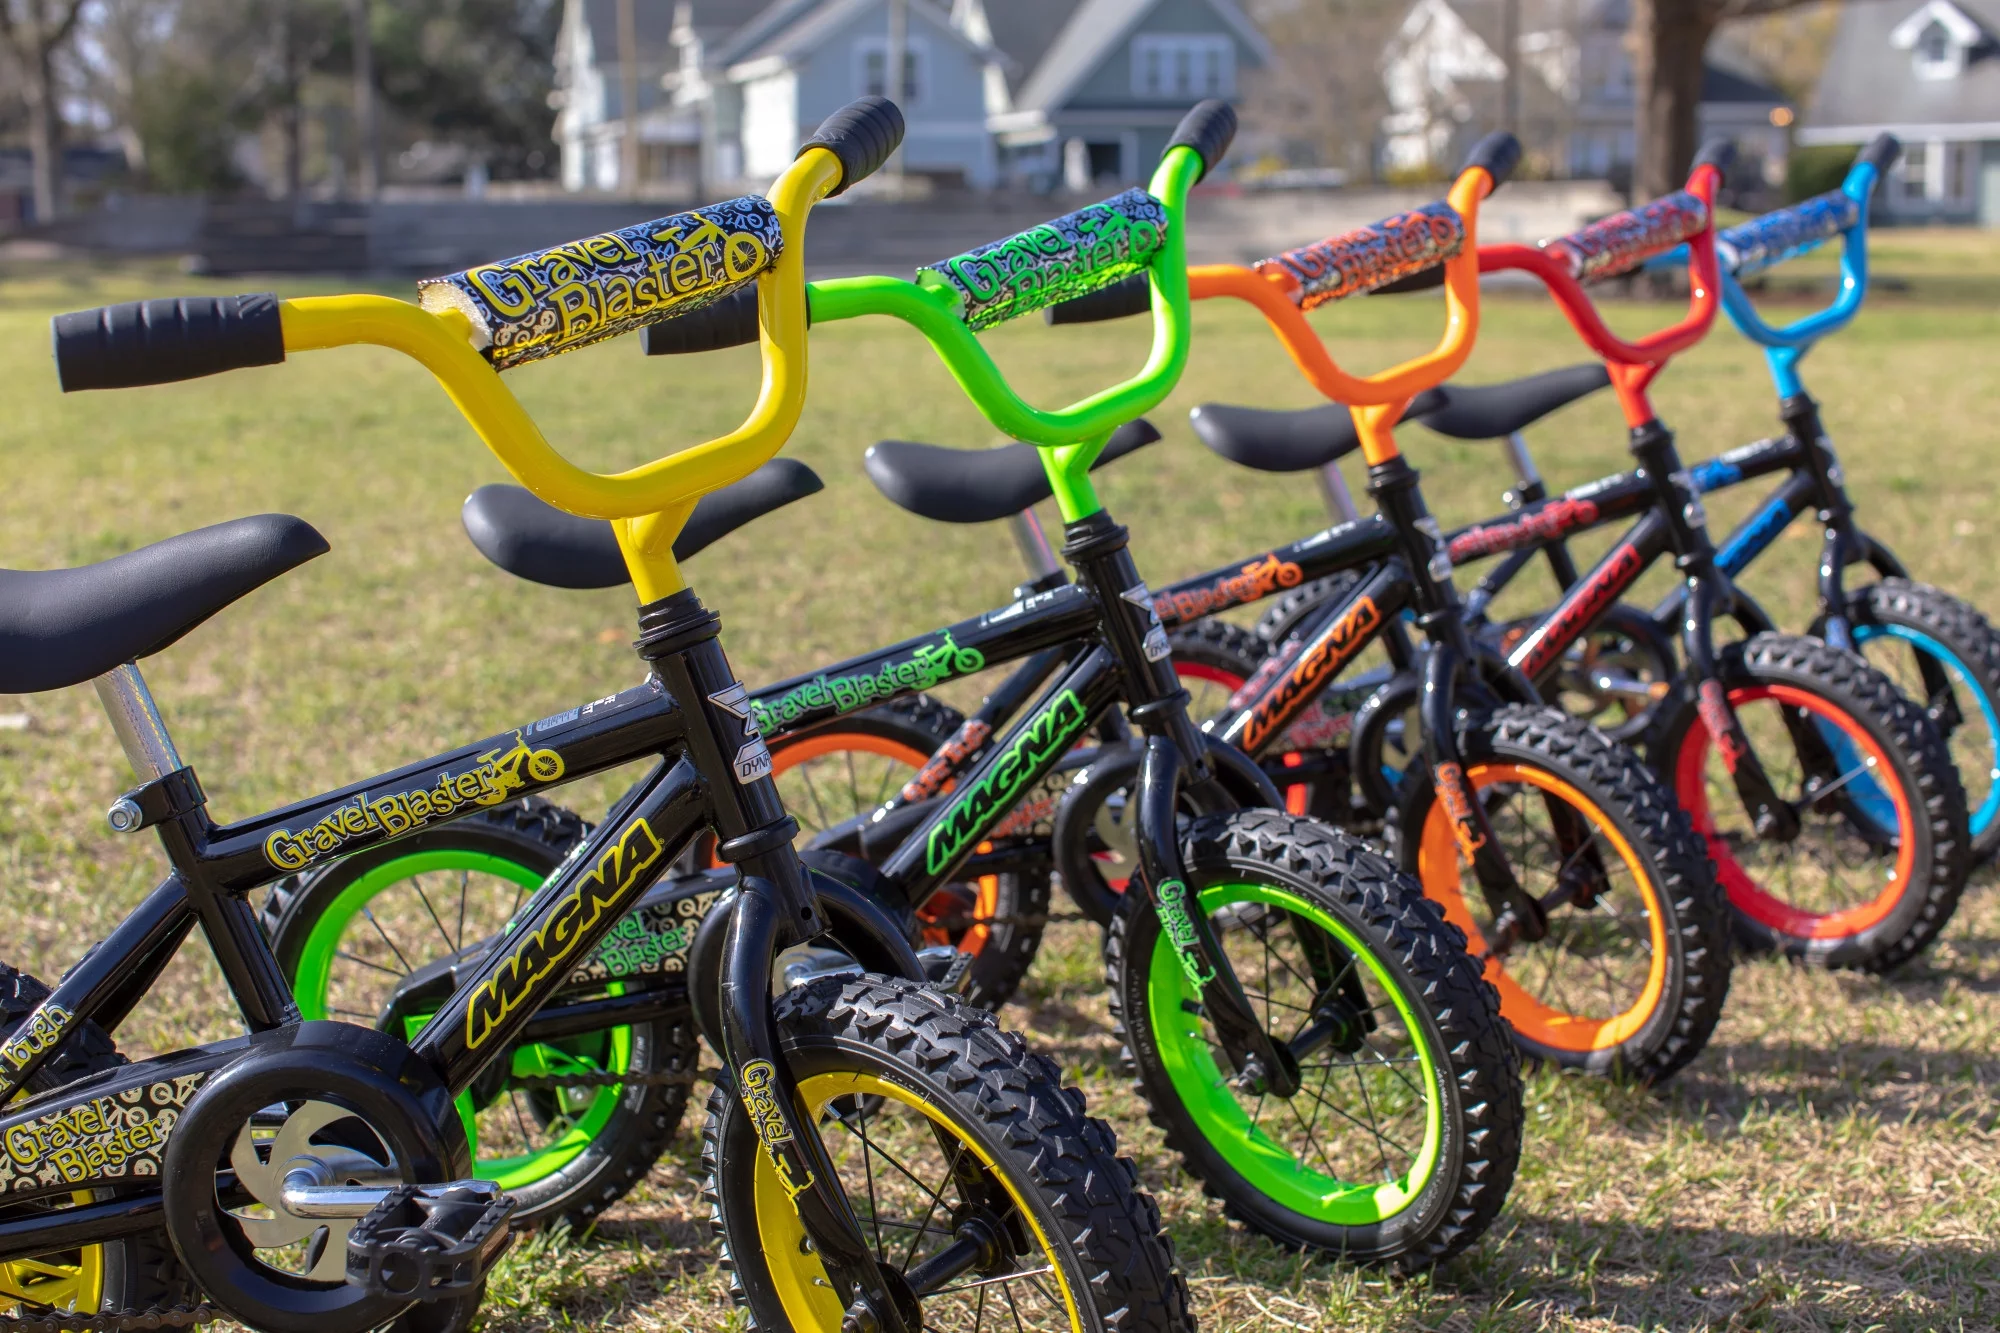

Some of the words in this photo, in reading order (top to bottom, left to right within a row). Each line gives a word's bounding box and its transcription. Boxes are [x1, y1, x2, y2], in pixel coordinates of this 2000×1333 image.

[466, 232, 638, 318] Gravel
[549, 242, 716, 347] Blaster
[950, 224, 1072, 301] Gravel
[1007, 230, 1127, 316] Blaster
[750, 675, 829, 735] Gravel
[827, 657, 928, 713] Blaster
[1243, 595, 1381, 752] MAGNA
[263, 794, 379, 871] Gravel
[371, 764, 495, 839] Blaster
[927, 689, 1086, 876] MAGNA
[466, 817, 663, 1049] MAGNA
[600, 925, 688, 977] Blaster
[2, 1005, 75, 1071] Tough
[4, 1099, 112, 1166] Gravel
[741, 1058, 795, 1144] Gravel
[50, 1117, 163, 1183] Blaster
